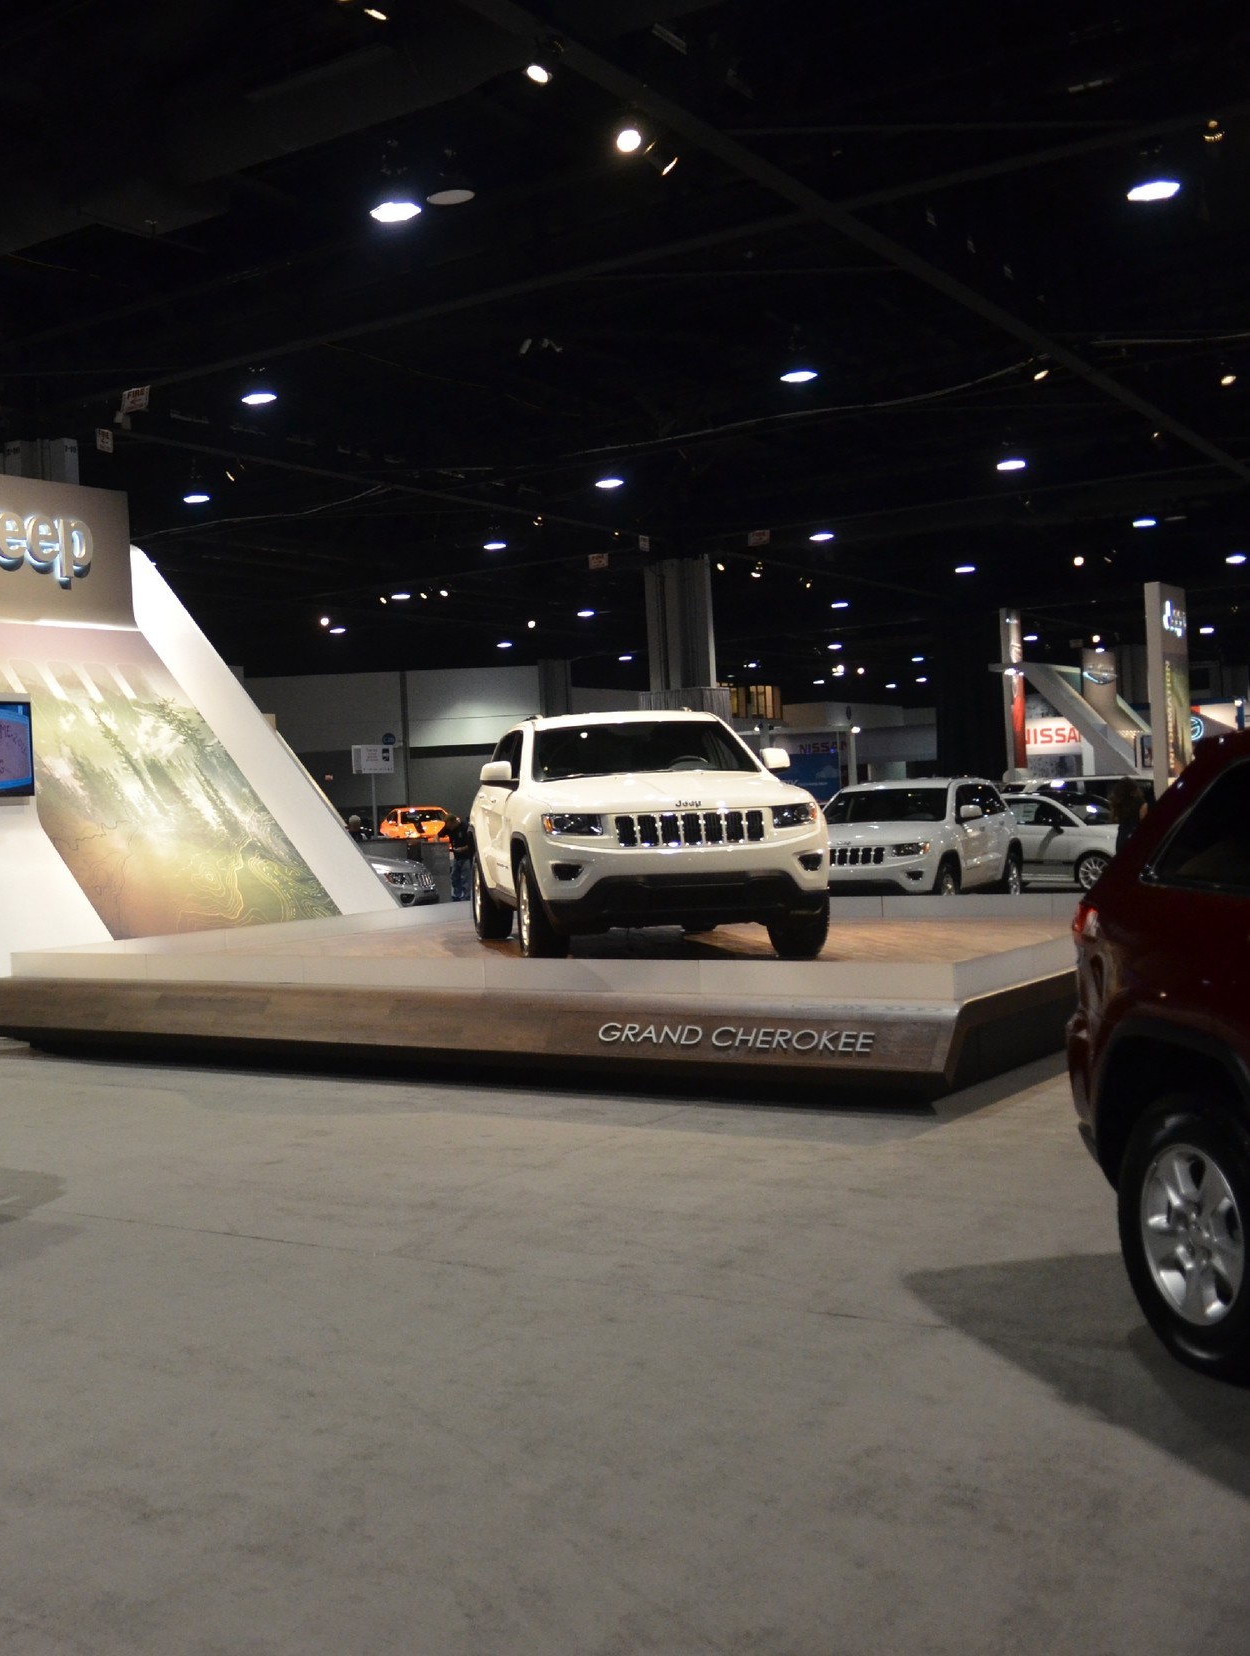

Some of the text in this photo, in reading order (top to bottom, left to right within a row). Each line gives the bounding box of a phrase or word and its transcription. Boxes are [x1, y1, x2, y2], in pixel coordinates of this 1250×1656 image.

[127, 389, 145, 399] FIRE
[598, 1022, 875, 1052] GRAND CHEROKEE
